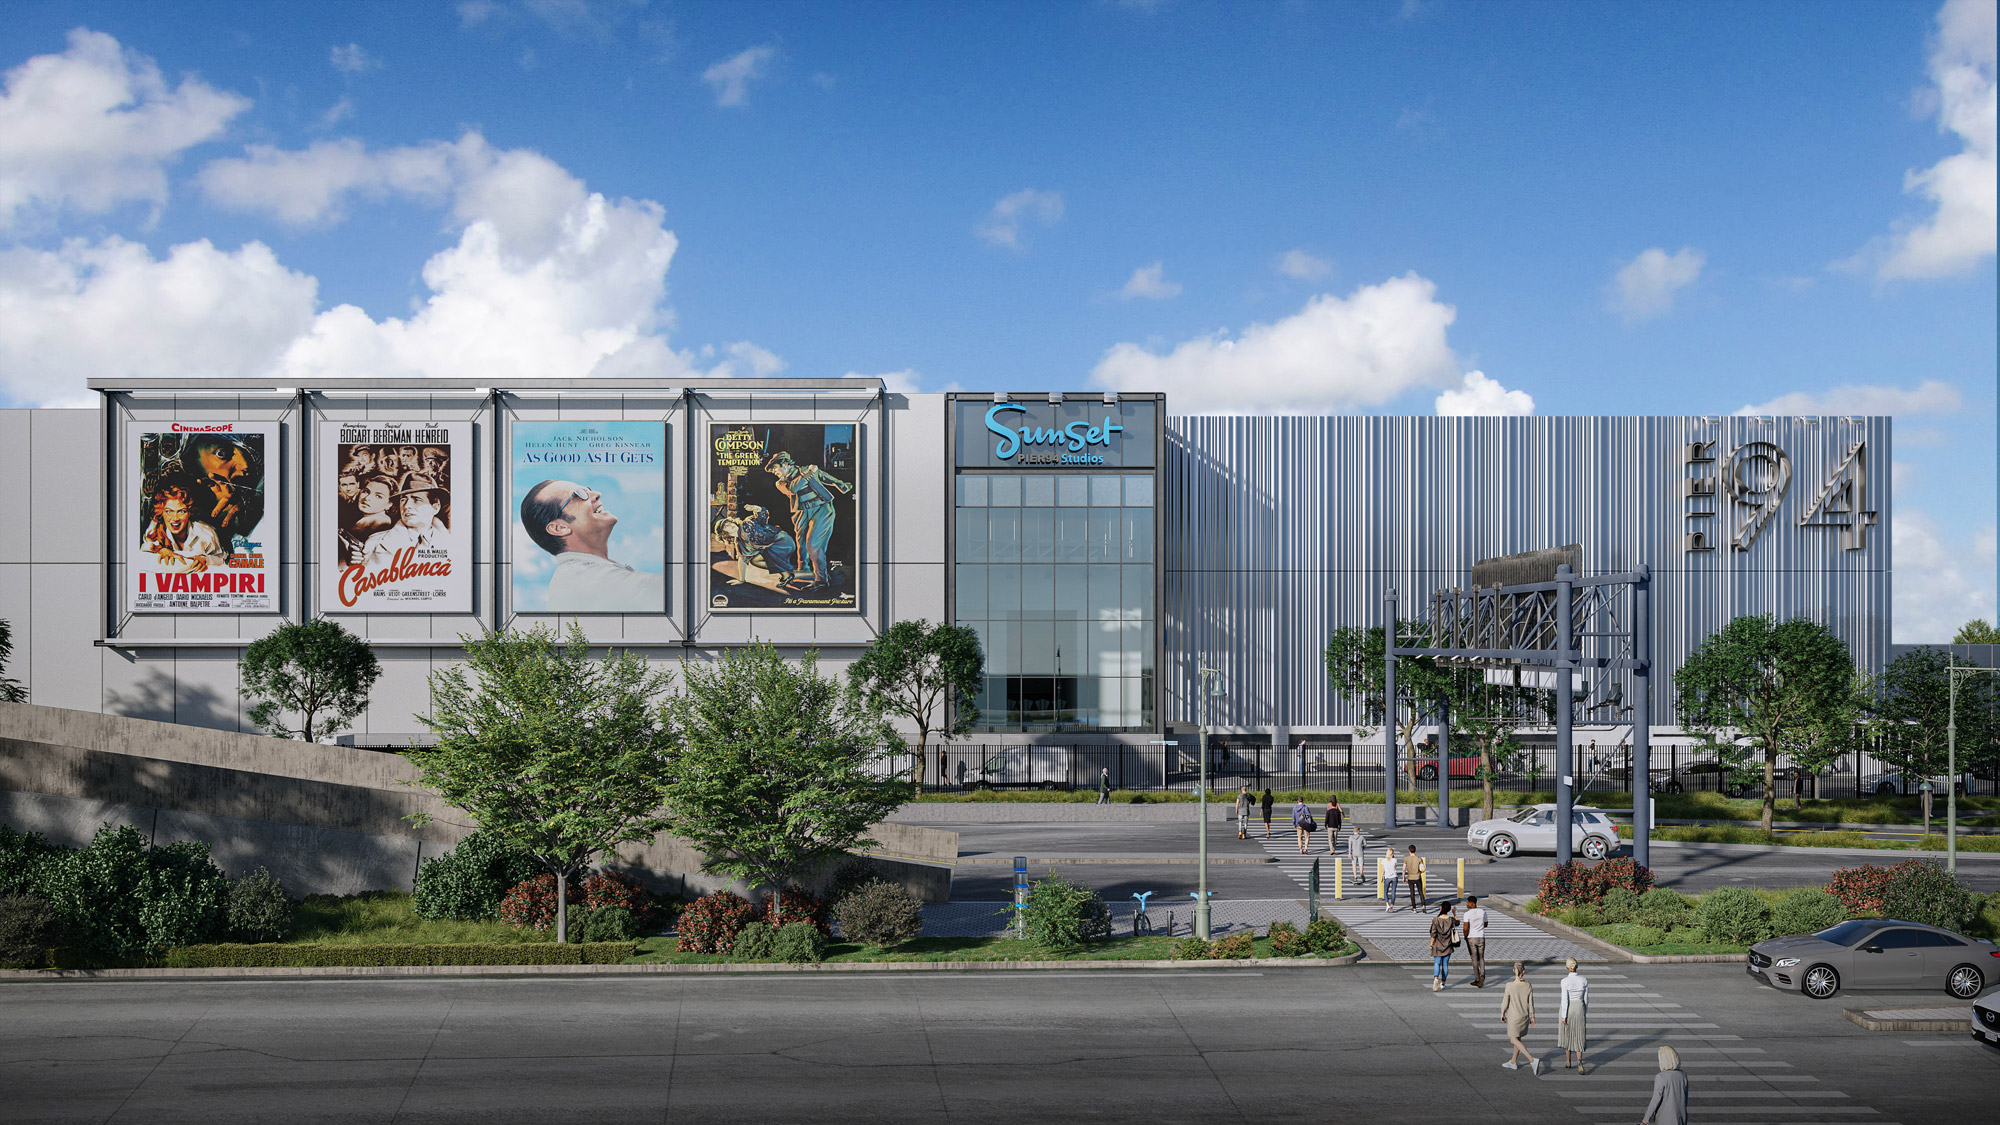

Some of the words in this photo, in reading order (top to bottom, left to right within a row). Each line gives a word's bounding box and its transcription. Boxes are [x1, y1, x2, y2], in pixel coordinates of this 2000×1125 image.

[340, 429, 371, 443] BOGART
[373, 429, 412, 443] BERGMAN
[415, 429, 449, 443] HENREID
[715, 437, 764, 451] COMPSON
[544, 451, 580, 463] GOOD
[620, 451, 654, 463] GETS
[1018, 454, 1059, 464] PIER94
[1062, 453, 1104, 463] Studios
[1686, 440, 1716, 552] PIER
[1722, 441, 1878, 552] 94
[229, 559, 264, 568] CANALE
[139, 573, 147, 593] I
[155, 573, 265, 593] VAMPIRI
